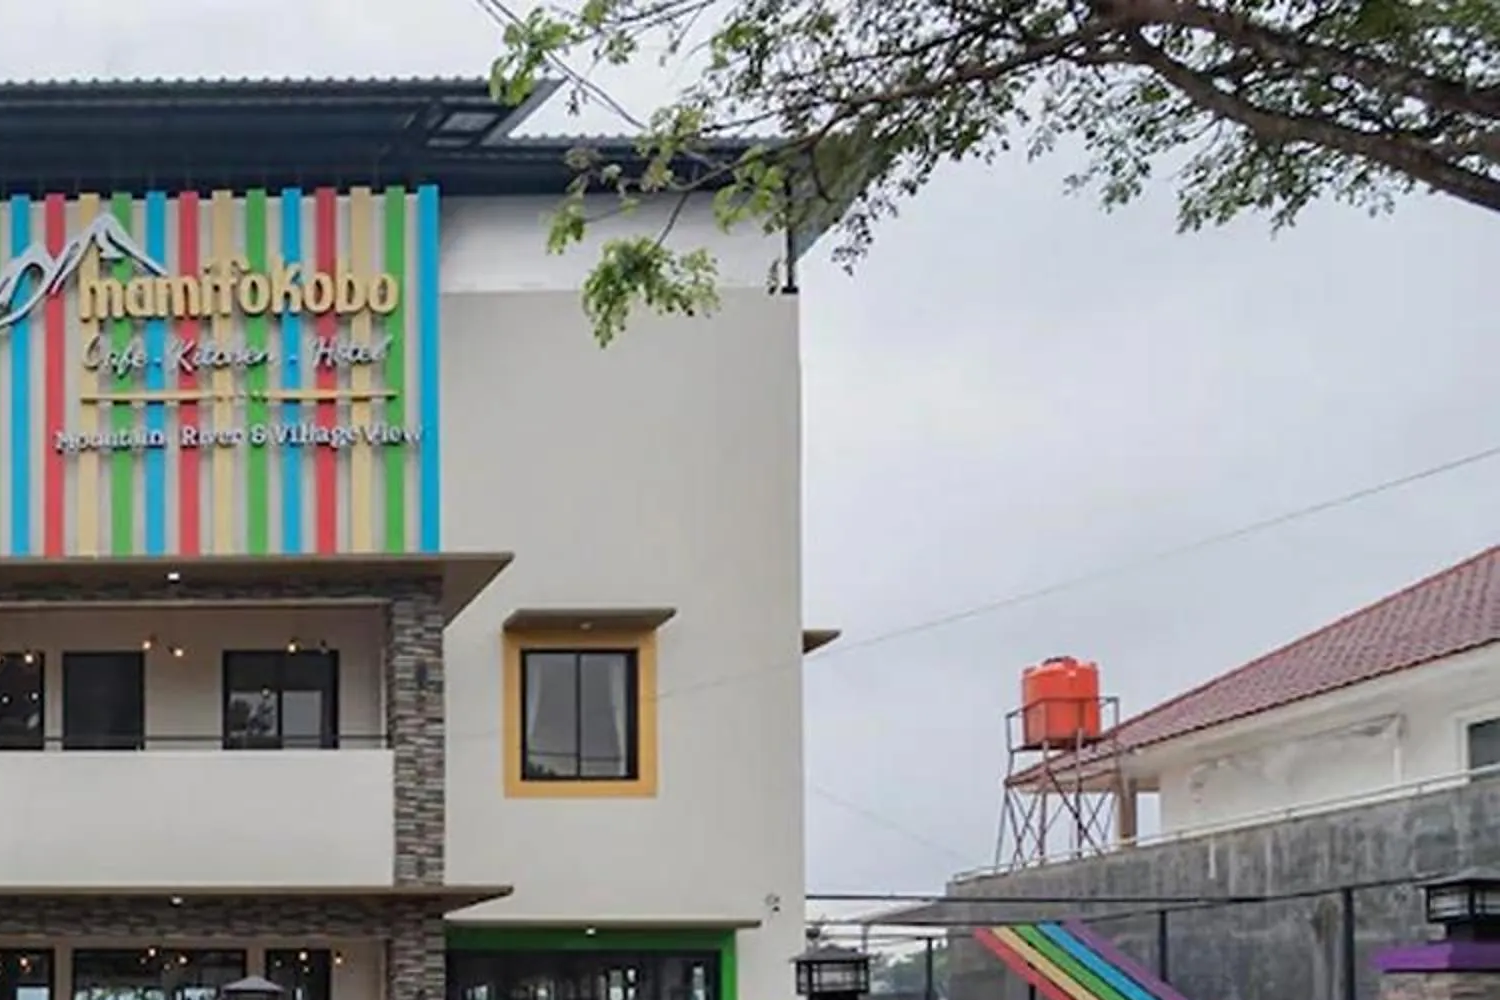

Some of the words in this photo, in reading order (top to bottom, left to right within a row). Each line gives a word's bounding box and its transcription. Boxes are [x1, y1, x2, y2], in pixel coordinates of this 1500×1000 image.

[82, 334, 149, 377] Cafe
[311, 334, 393, 369] Hotel
[271, 420, 359, 450] Village
[359, 421, 424, 444] View
